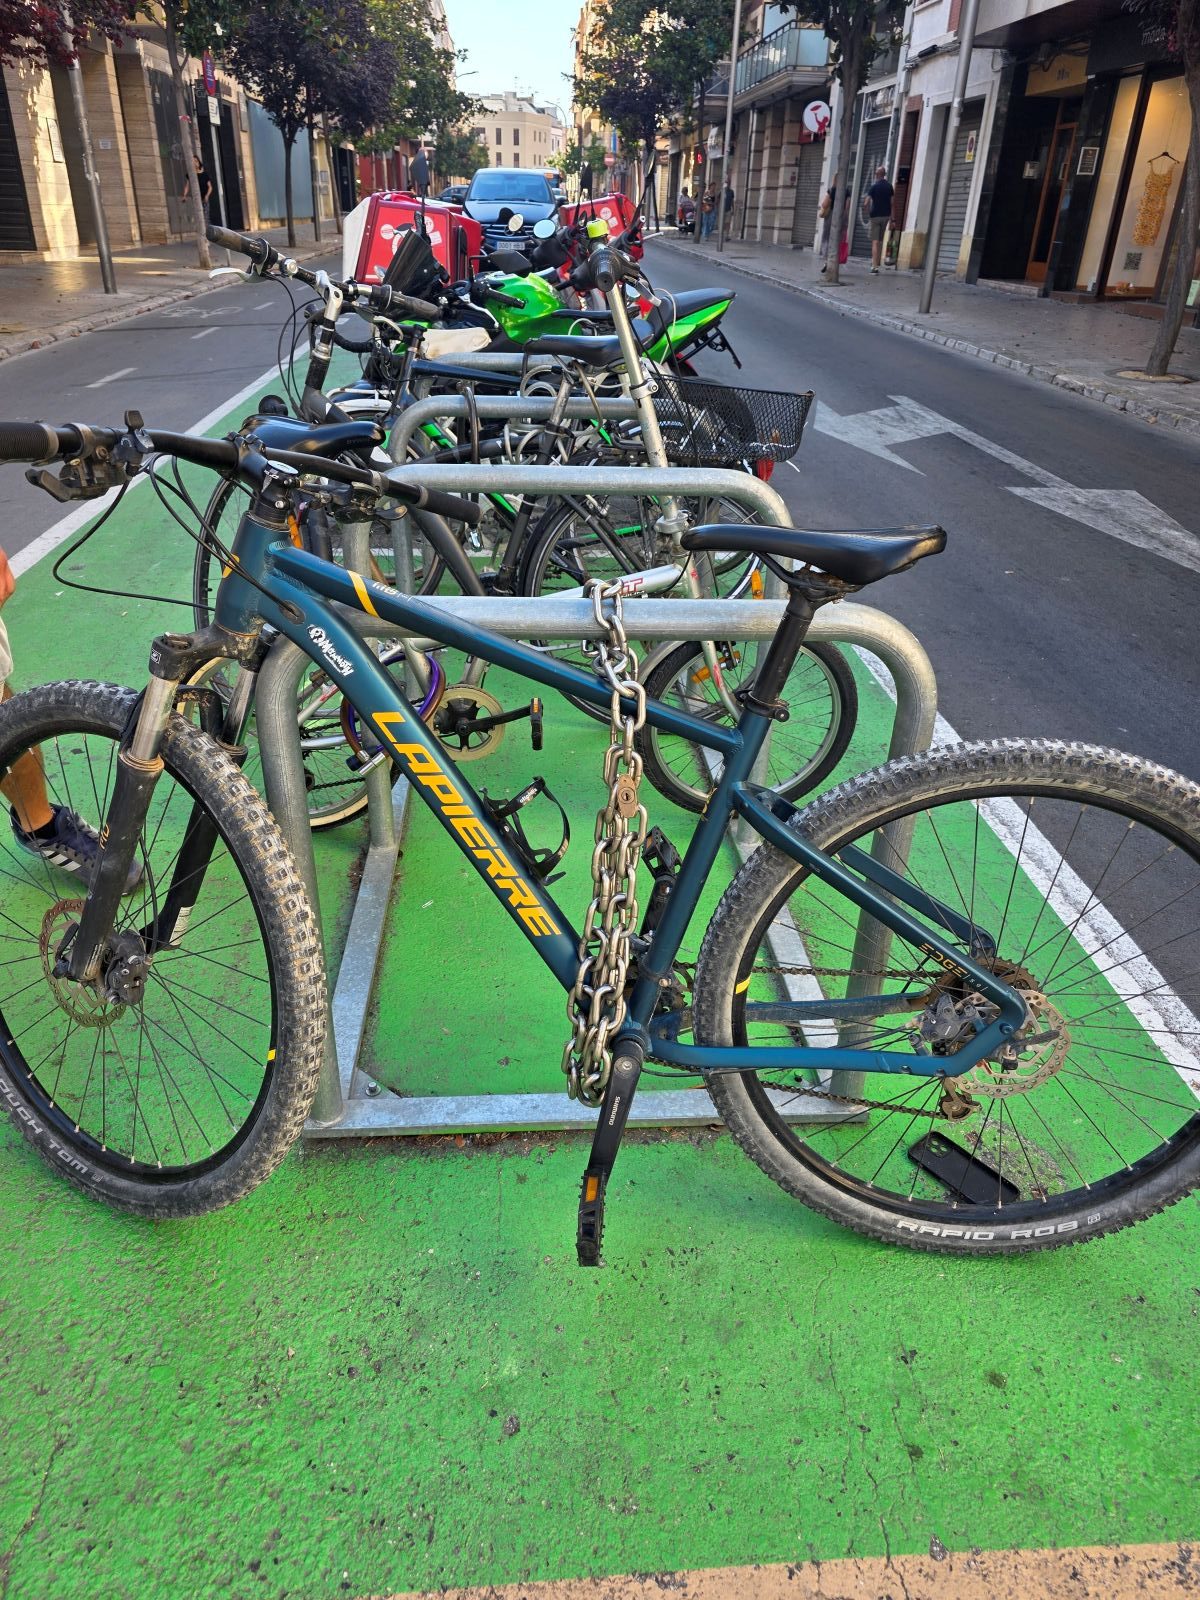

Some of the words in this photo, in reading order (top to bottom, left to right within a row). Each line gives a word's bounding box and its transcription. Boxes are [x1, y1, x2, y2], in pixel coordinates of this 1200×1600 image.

[371, 711, 562, 937] LAPIERRE
[918, 943, 968, 978] EDGE
[48, 1139, 89, 1174] TOM
[896, 1220, 995, 1241] RAPID
[1010, 1220, 1079, 1240] ROB
